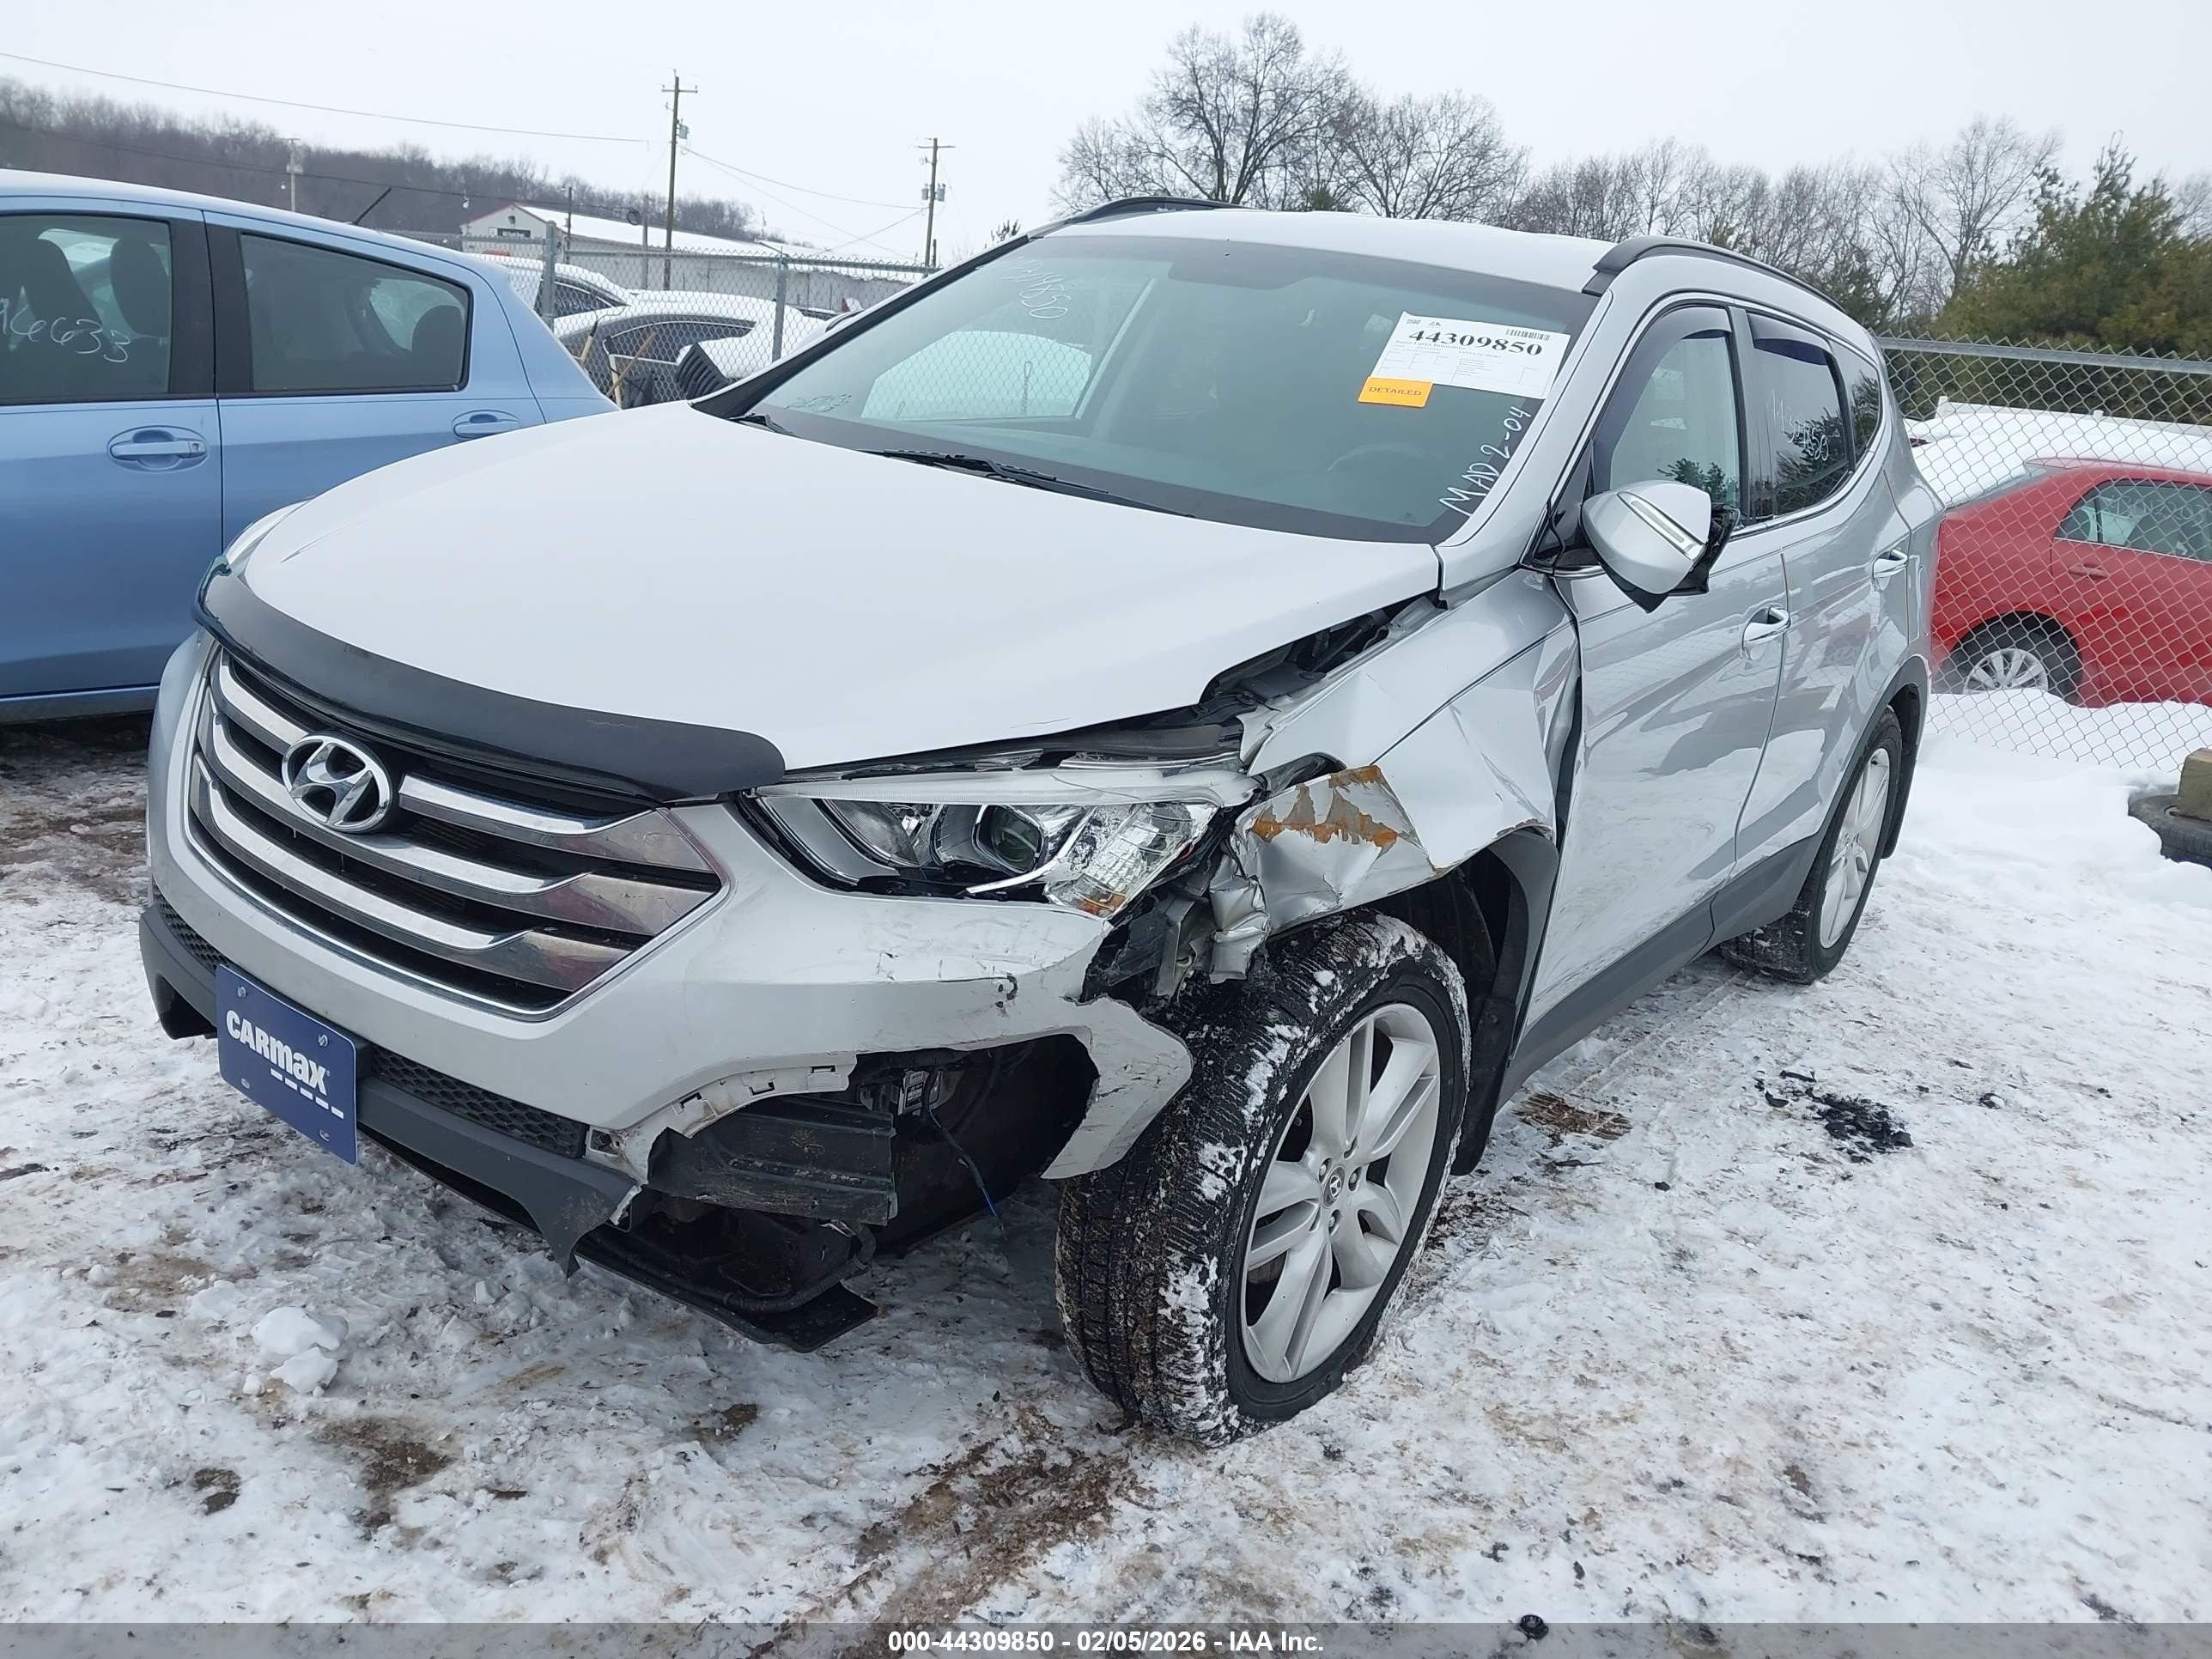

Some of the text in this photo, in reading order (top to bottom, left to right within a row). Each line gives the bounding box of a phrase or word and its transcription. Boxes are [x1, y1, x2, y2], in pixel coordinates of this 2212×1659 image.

[1408, 330, 1543, 356] 44309850
[1368, 386, 1422, 397] DETAILED
[1438, 406, 1532, 517] MAD 2-04
